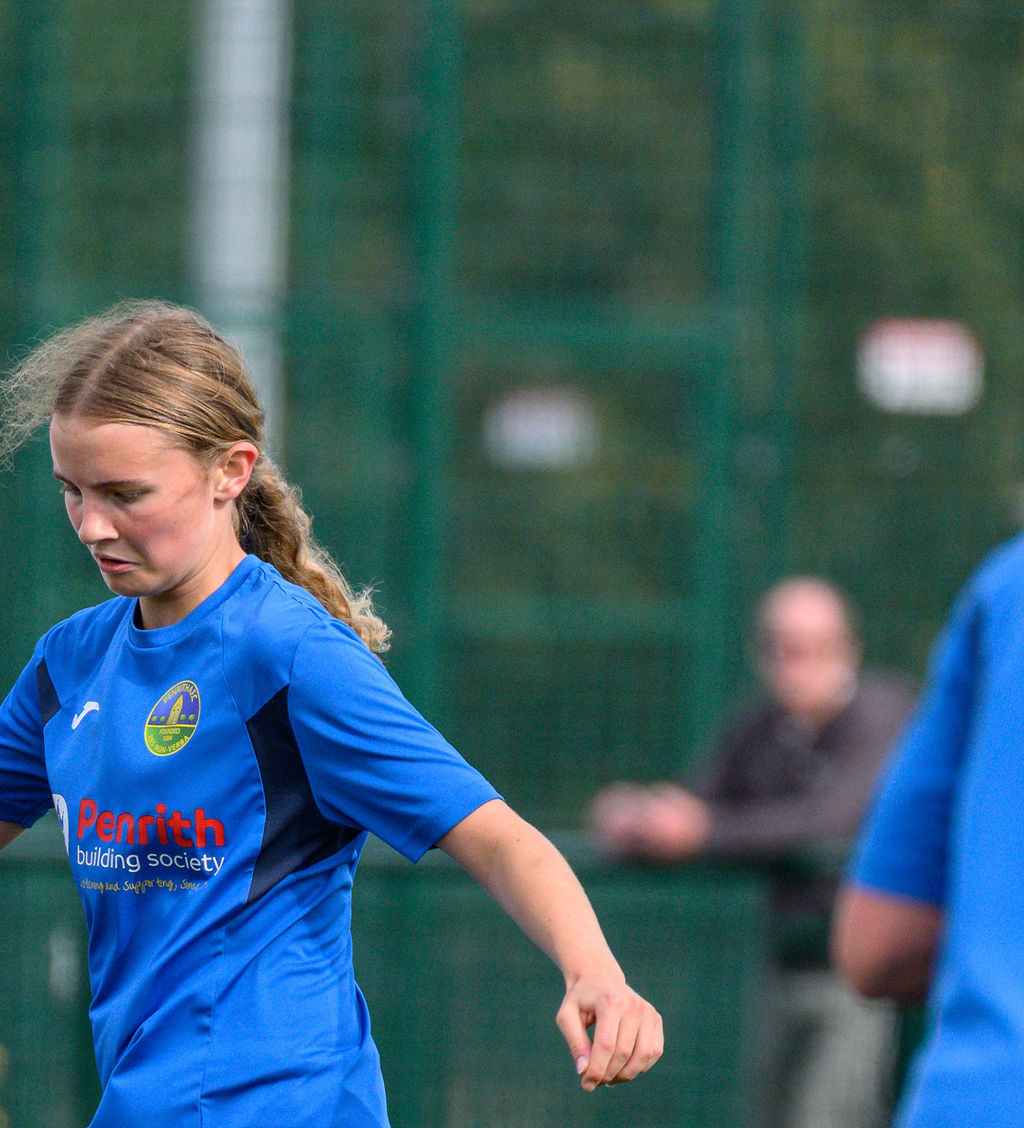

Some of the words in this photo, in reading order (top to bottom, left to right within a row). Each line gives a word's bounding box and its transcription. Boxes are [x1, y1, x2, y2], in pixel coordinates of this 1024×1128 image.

[77, 798, 225, 848] Penrith
[76, 845, 141, 872] building
[147, 852, 225, 876] society
